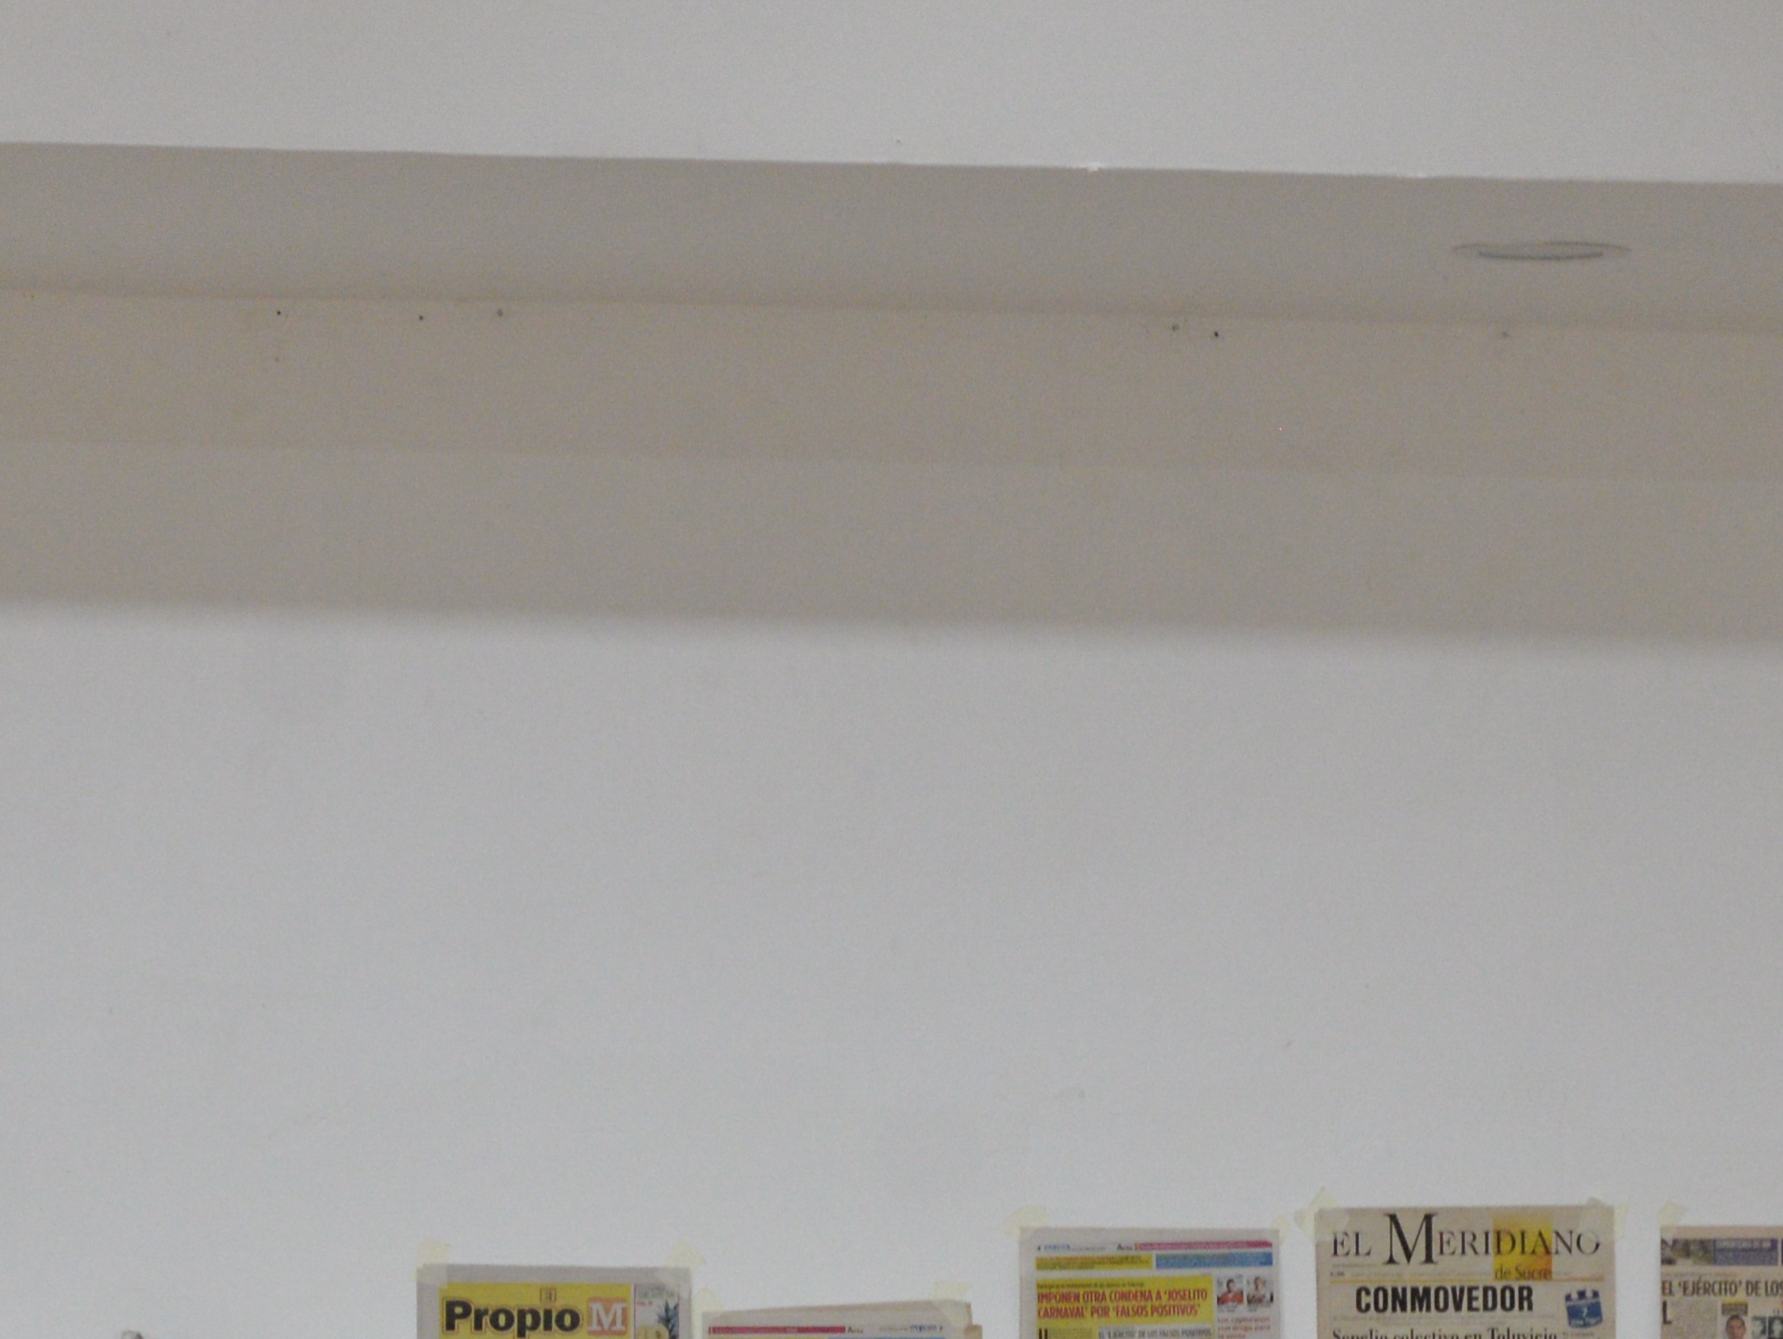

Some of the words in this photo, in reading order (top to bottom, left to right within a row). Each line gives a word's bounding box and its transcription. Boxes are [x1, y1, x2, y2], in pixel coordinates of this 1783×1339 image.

[1332, 1231, 1371, 1257] EL
[1383, 1213, 1601, 1265] MERIDIANO
[1355, 1285, 1534, 1314] CONMOVEDOR
[1662, 1281, 1674, 1297] EL
[1746, 1281, 1761, 1297] DE
[444, 1299, 581, 1339] Propio
